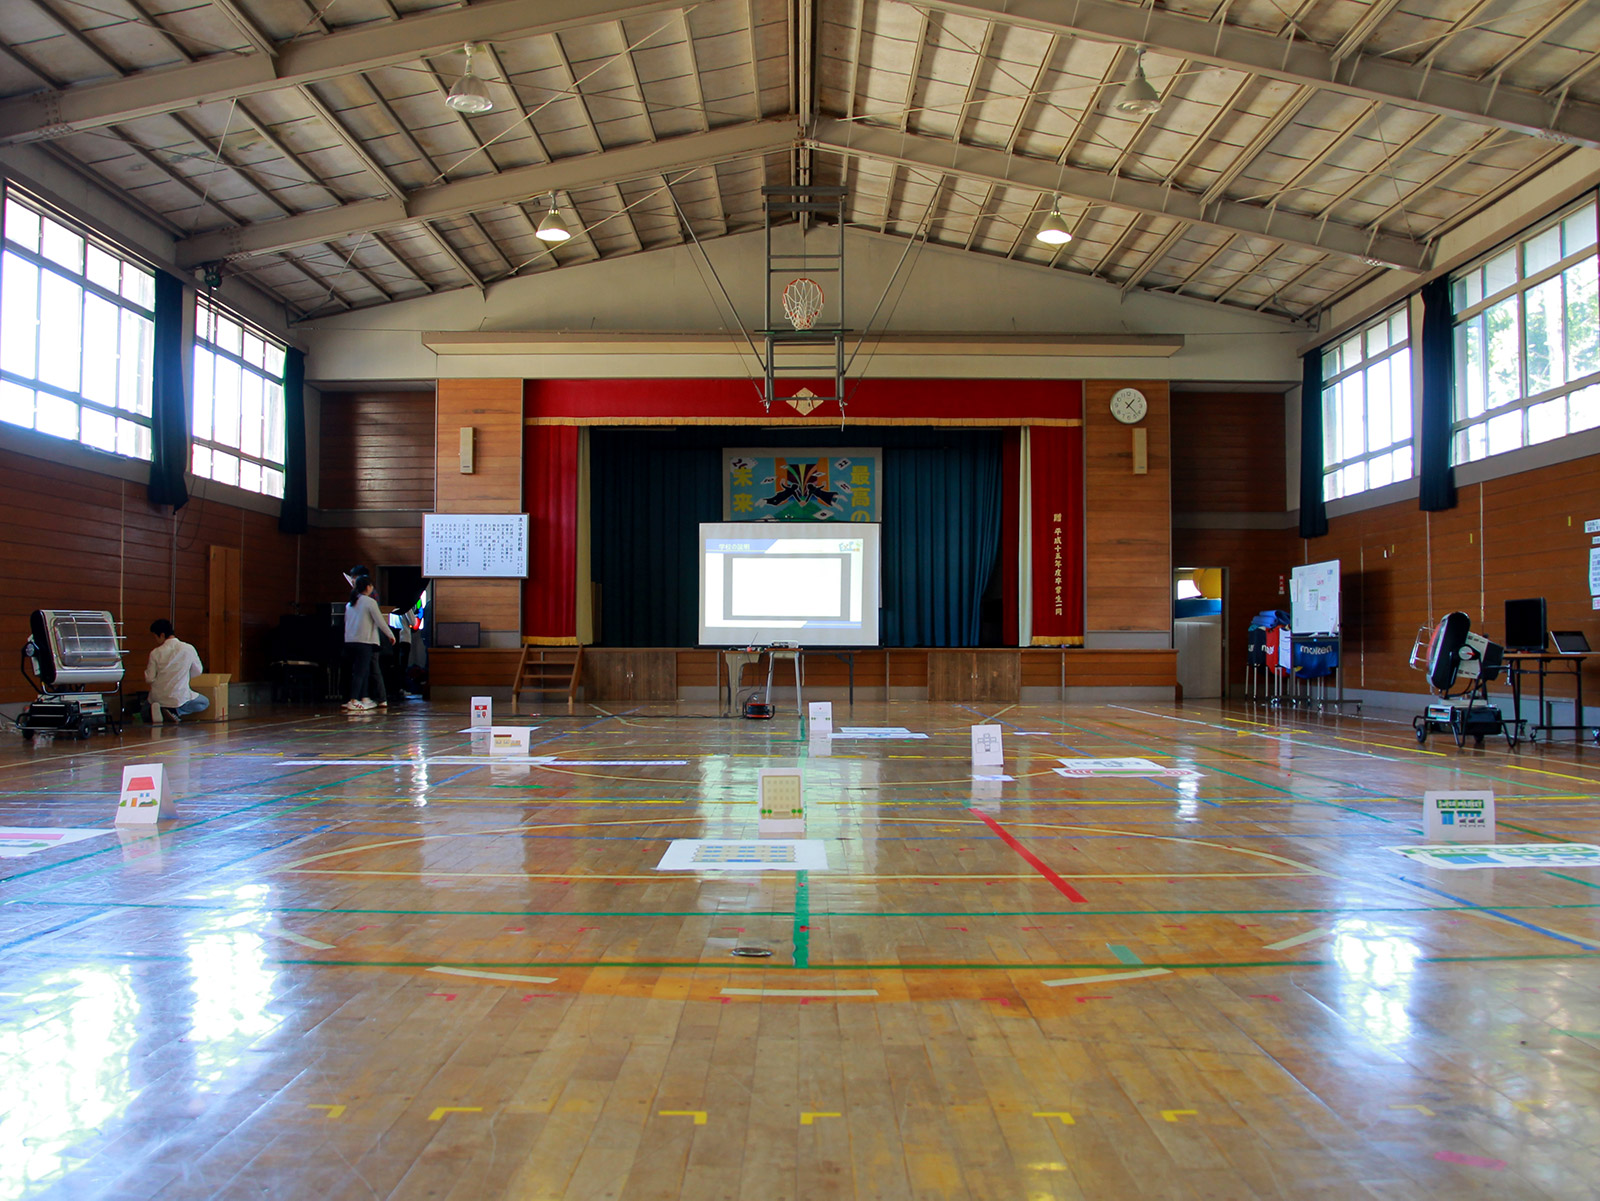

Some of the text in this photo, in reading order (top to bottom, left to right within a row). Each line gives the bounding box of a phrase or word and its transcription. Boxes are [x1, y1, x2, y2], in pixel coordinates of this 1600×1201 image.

[733, 466, 753, 513] 未来
[850, 465, 871, 522] 最高の
[1054, 528, 1062, 616] 平成十五年度卒業生一同
